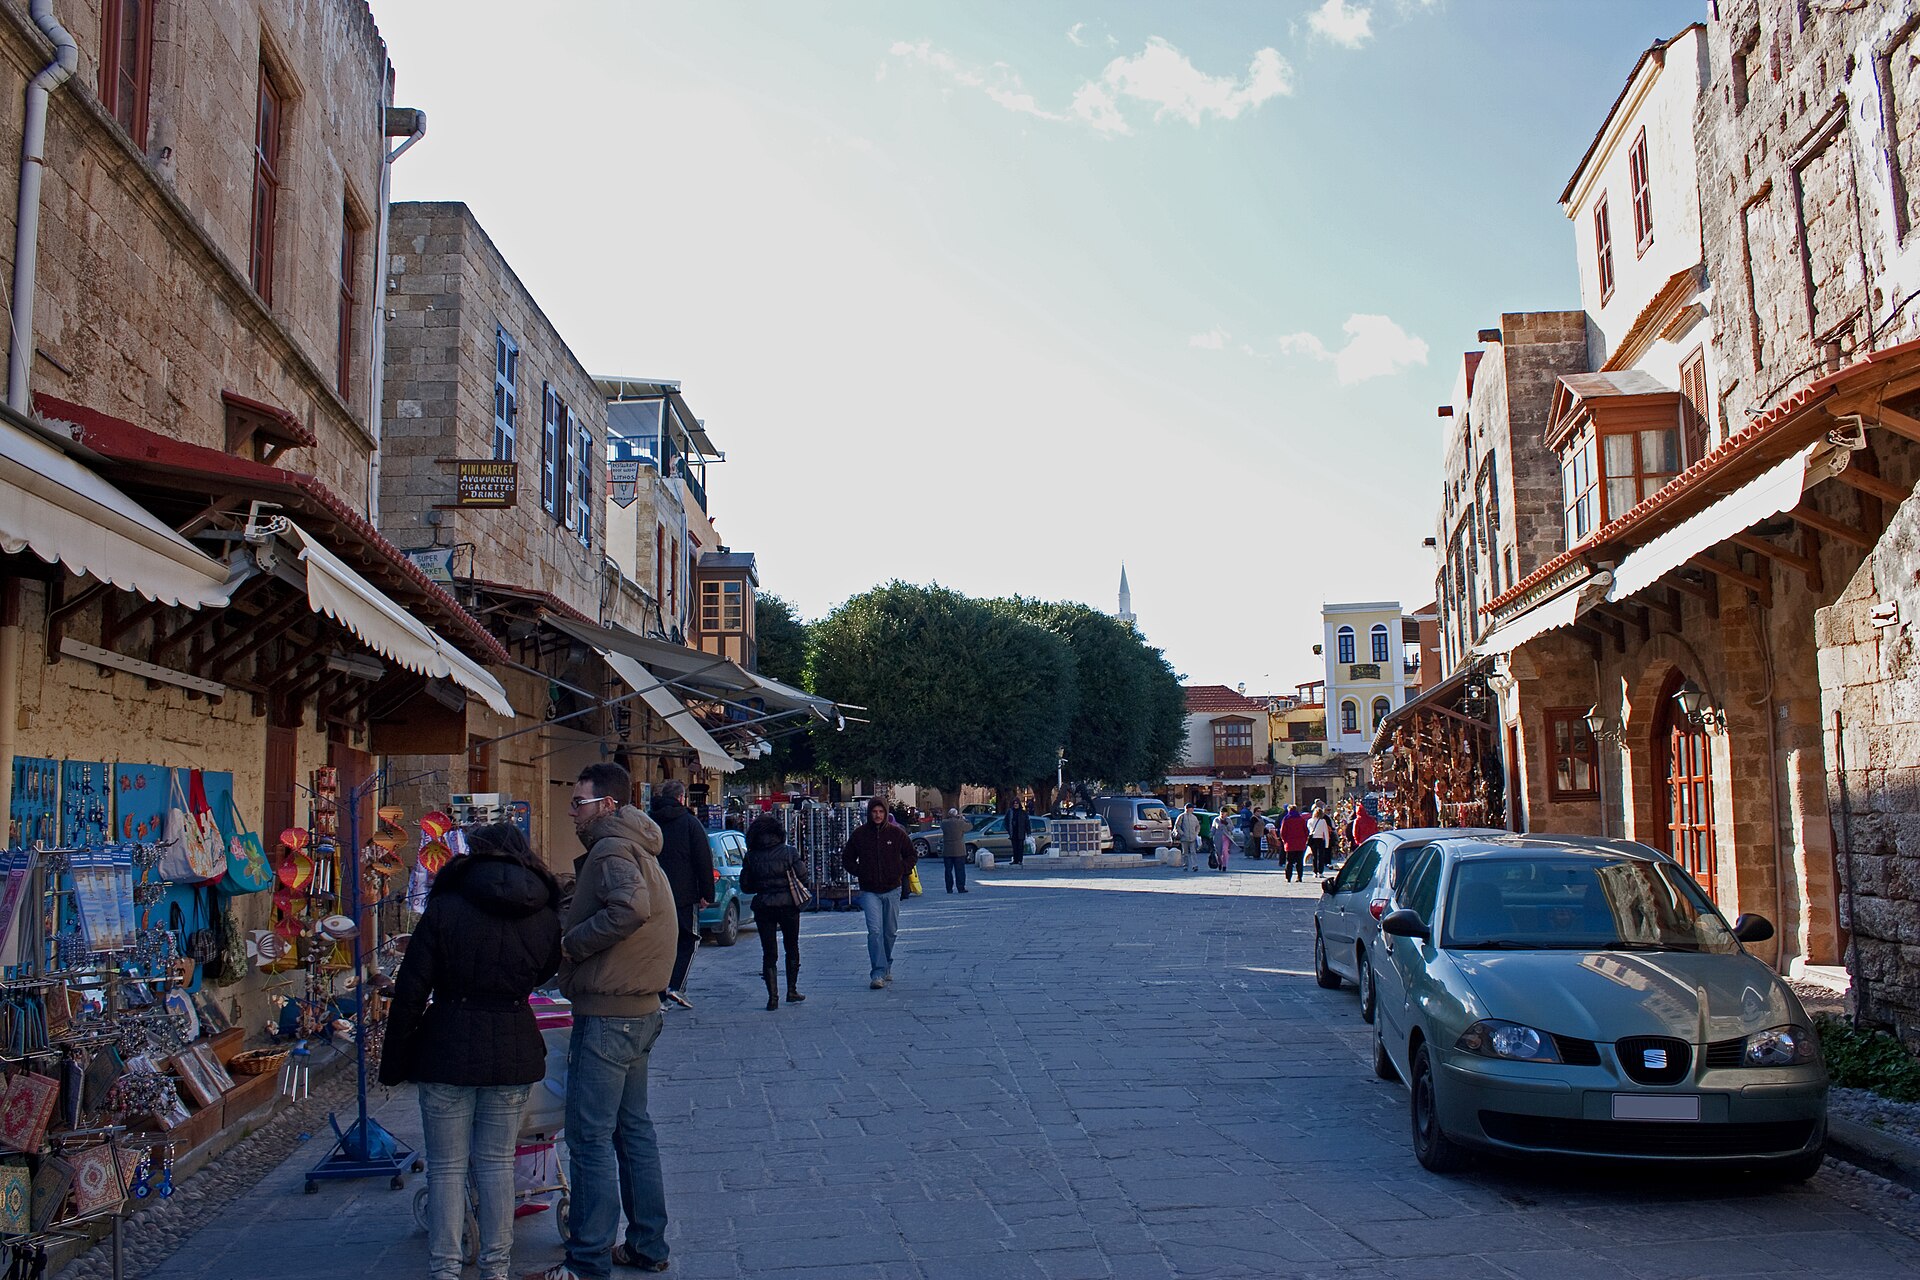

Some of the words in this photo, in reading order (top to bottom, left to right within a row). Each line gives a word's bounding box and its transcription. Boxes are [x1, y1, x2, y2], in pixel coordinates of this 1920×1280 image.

[460, 464, 479, 475] MINI
[481, 464, 514, 475] MARKET
[460, 483, 515, 491] CIGARETTES
[471, 490, 505, 499] DRINKS
